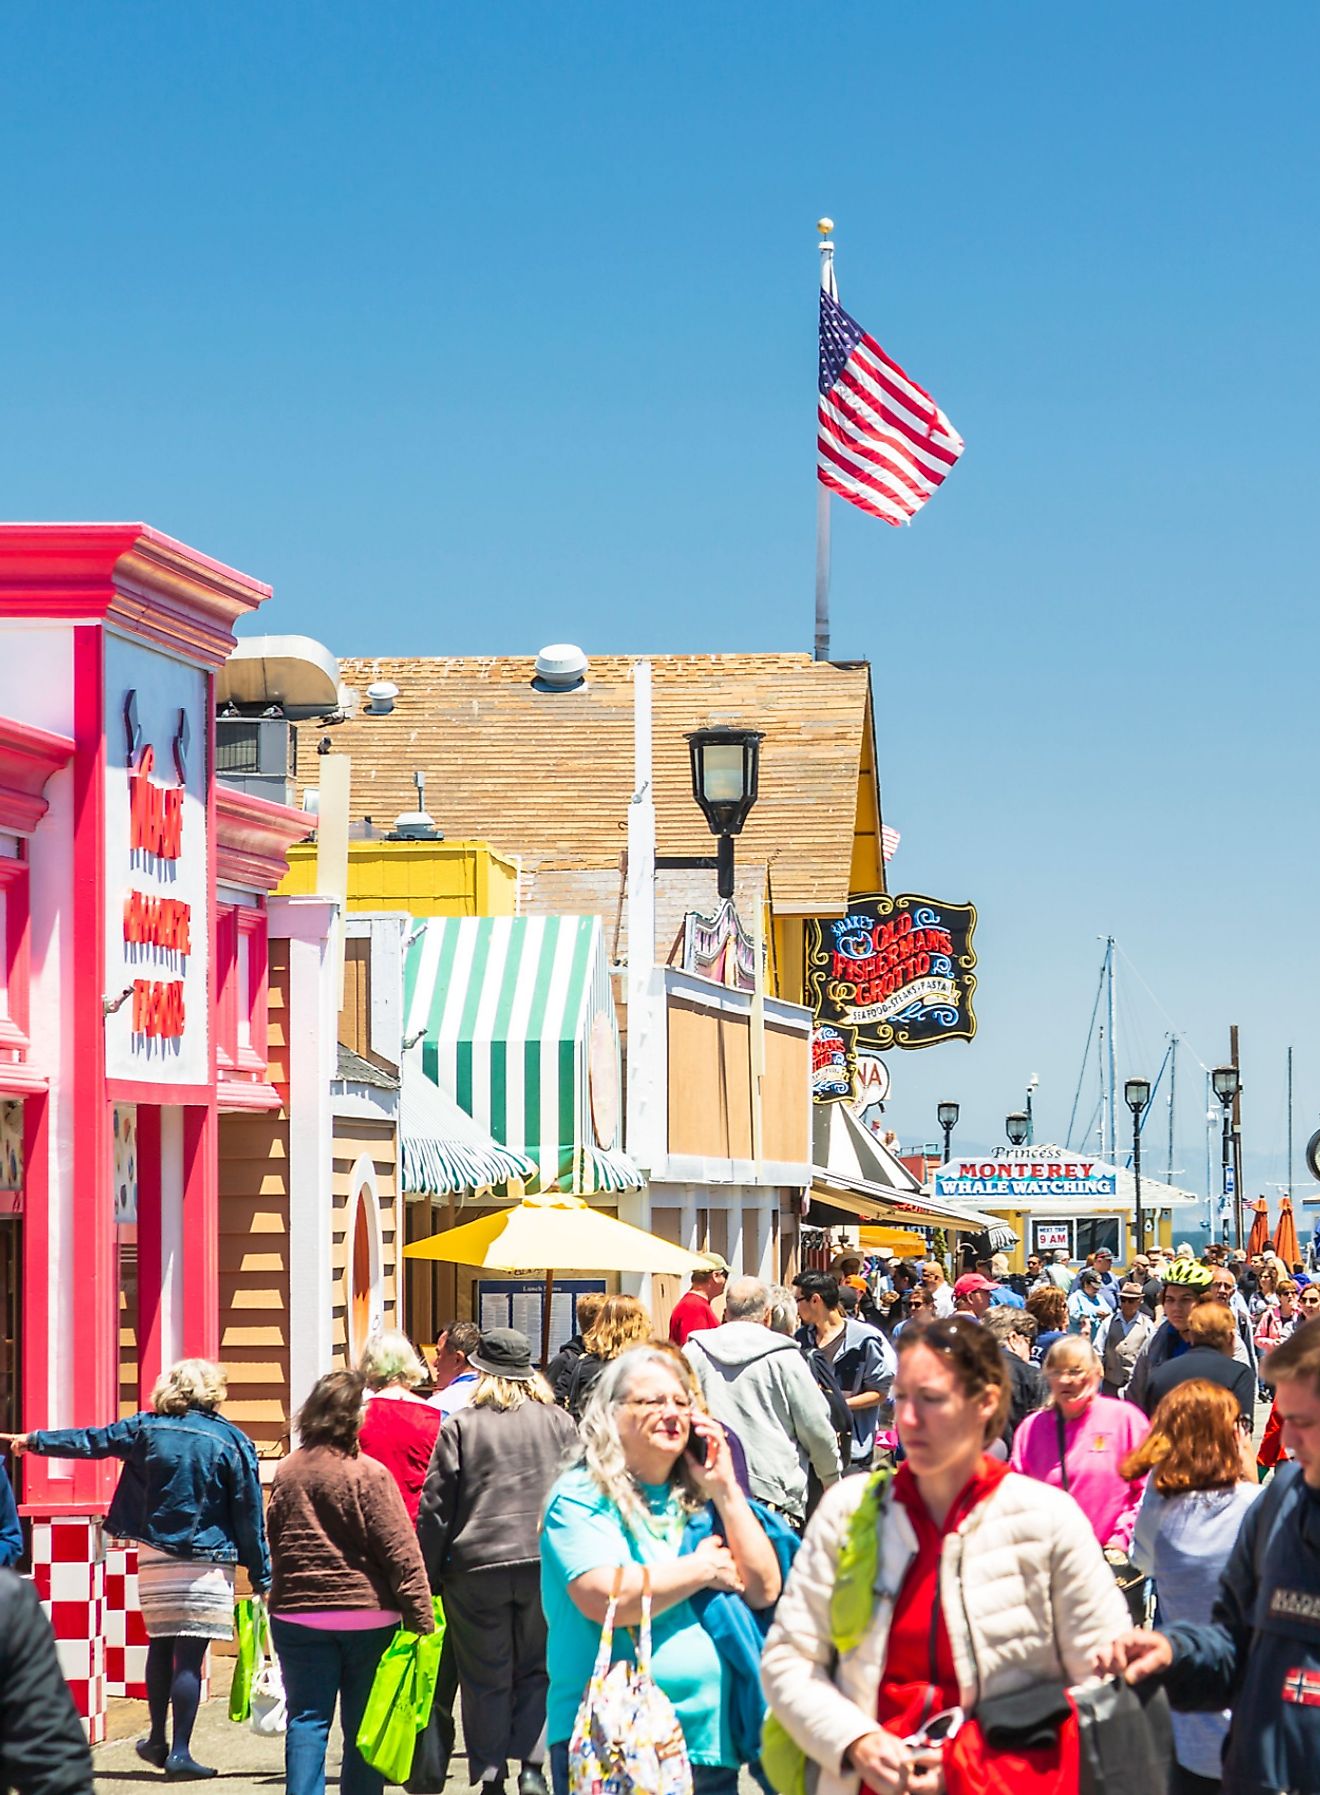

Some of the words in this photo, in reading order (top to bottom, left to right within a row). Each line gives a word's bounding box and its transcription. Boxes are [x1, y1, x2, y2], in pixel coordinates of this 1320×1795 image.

[872, 911, 912, 951] OLD
[855, 951, 931, 1006] GROTTO
[991, 1145, 1062, 1159] Princess
[959, 1163, 1094, 1178] MONTEREY
[941, 1180, 1006, 1195] WHALE
[1011, 1180, 1111, 1195] WATCHING
[1039, 1234, 1046, 1244] 9
[1050, 1234, 1067, 1244] AM
